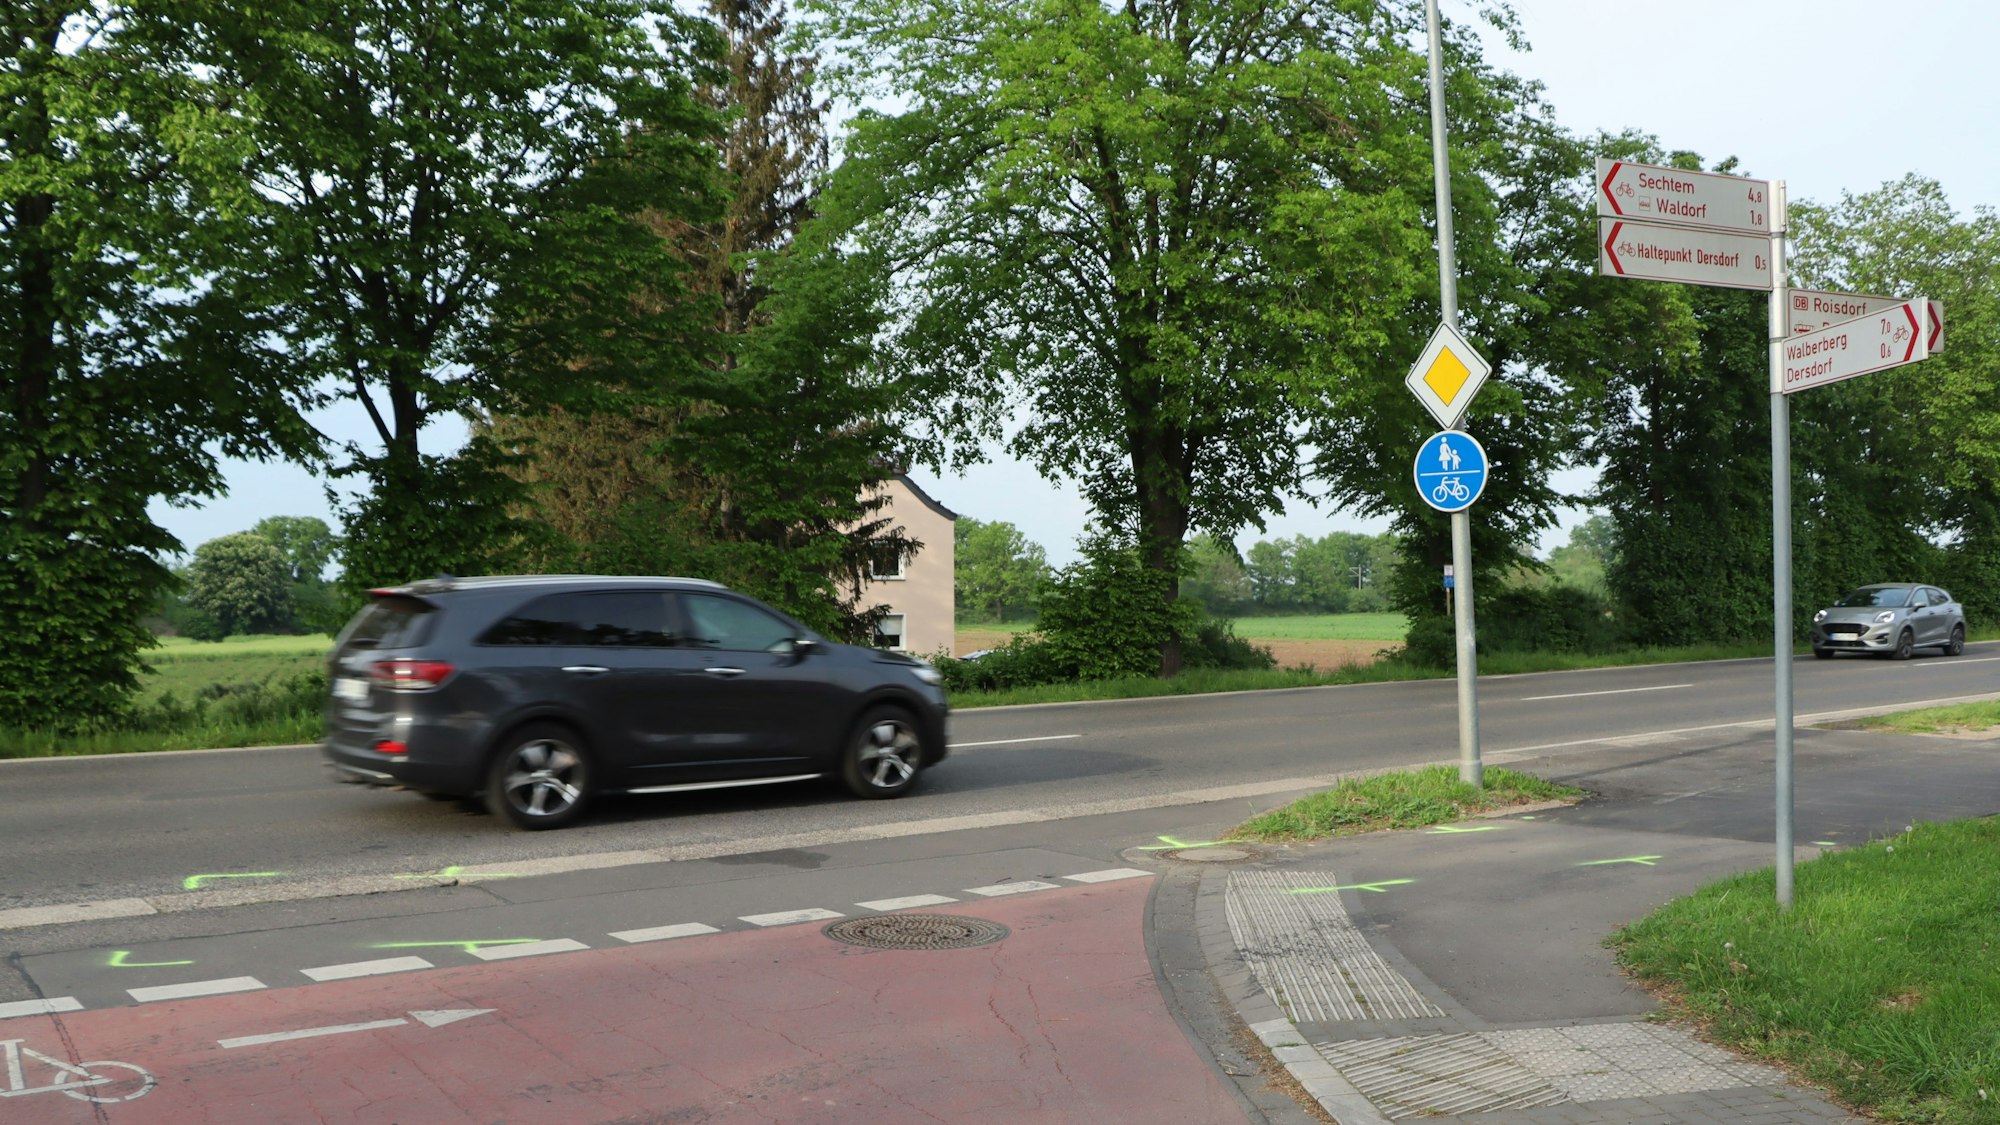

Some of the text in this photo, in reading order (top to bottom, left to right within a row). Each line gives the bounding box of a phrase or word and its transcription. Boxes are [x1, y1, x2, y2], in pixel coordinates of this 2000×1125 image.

[1639, 172, 1694, 194] Sechtem
[1656, 198, 1706, 218] Waldorf
[1637, 243, 1692, 264] Haltepunkt
[1697, 249, 1739, 267] Dersdorf
[1795, 297, 1867, 315] DB Roisdorf
[1787, 334, 1847, 360] Walberberg
[1787, 358, 1832, 383] Dersdorf
